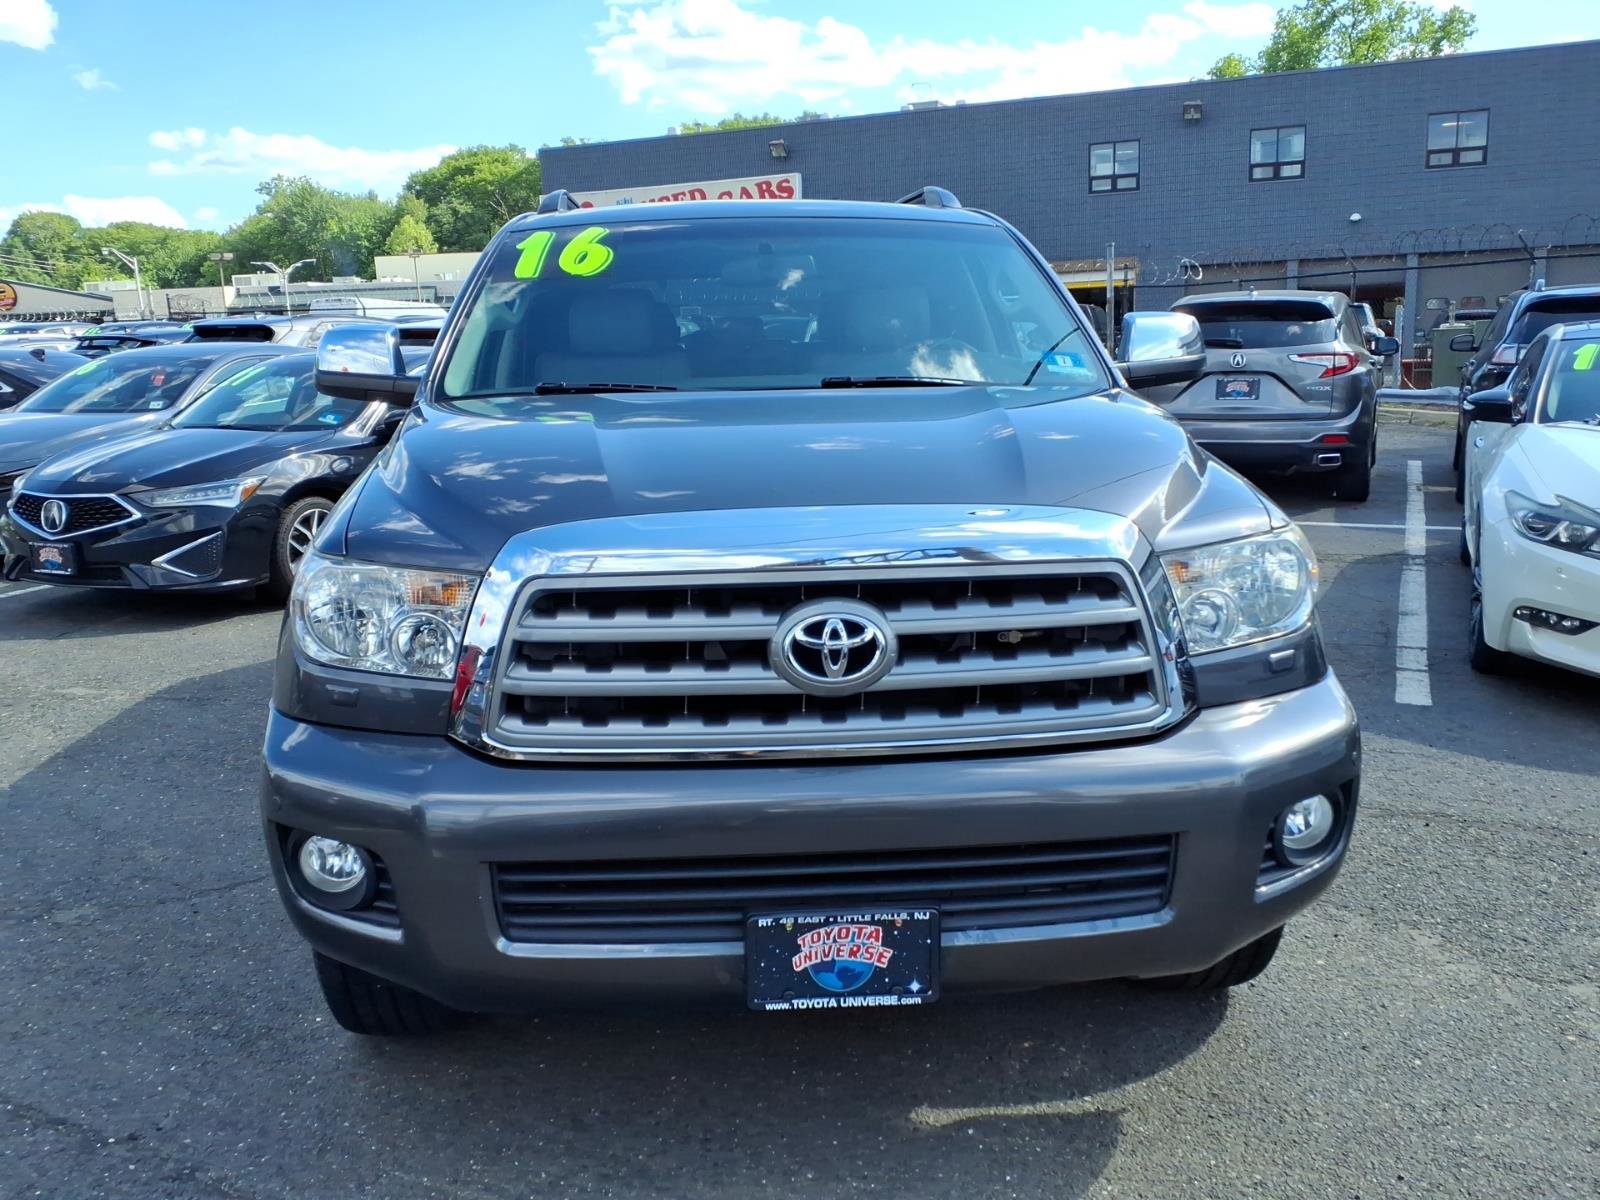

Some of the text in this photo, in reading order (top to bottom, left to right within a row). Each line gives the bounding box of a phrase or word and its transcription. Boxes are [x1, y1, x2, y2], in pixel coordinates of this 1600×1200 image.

[515, 226, 614, 278] 16
[758, 918, 776, 928] RT.
[797, 915, 826, 924] EAST
[837, 914, 872, 923] LITTLE
[914, 911, 930, 920] NJ
[797, 924, 883, 949] TOYOTA
[792, 943, 893, 972] UNIVERSE
[765, 995, 922, 1011] www.TOYOTA UNIVERSE.com
